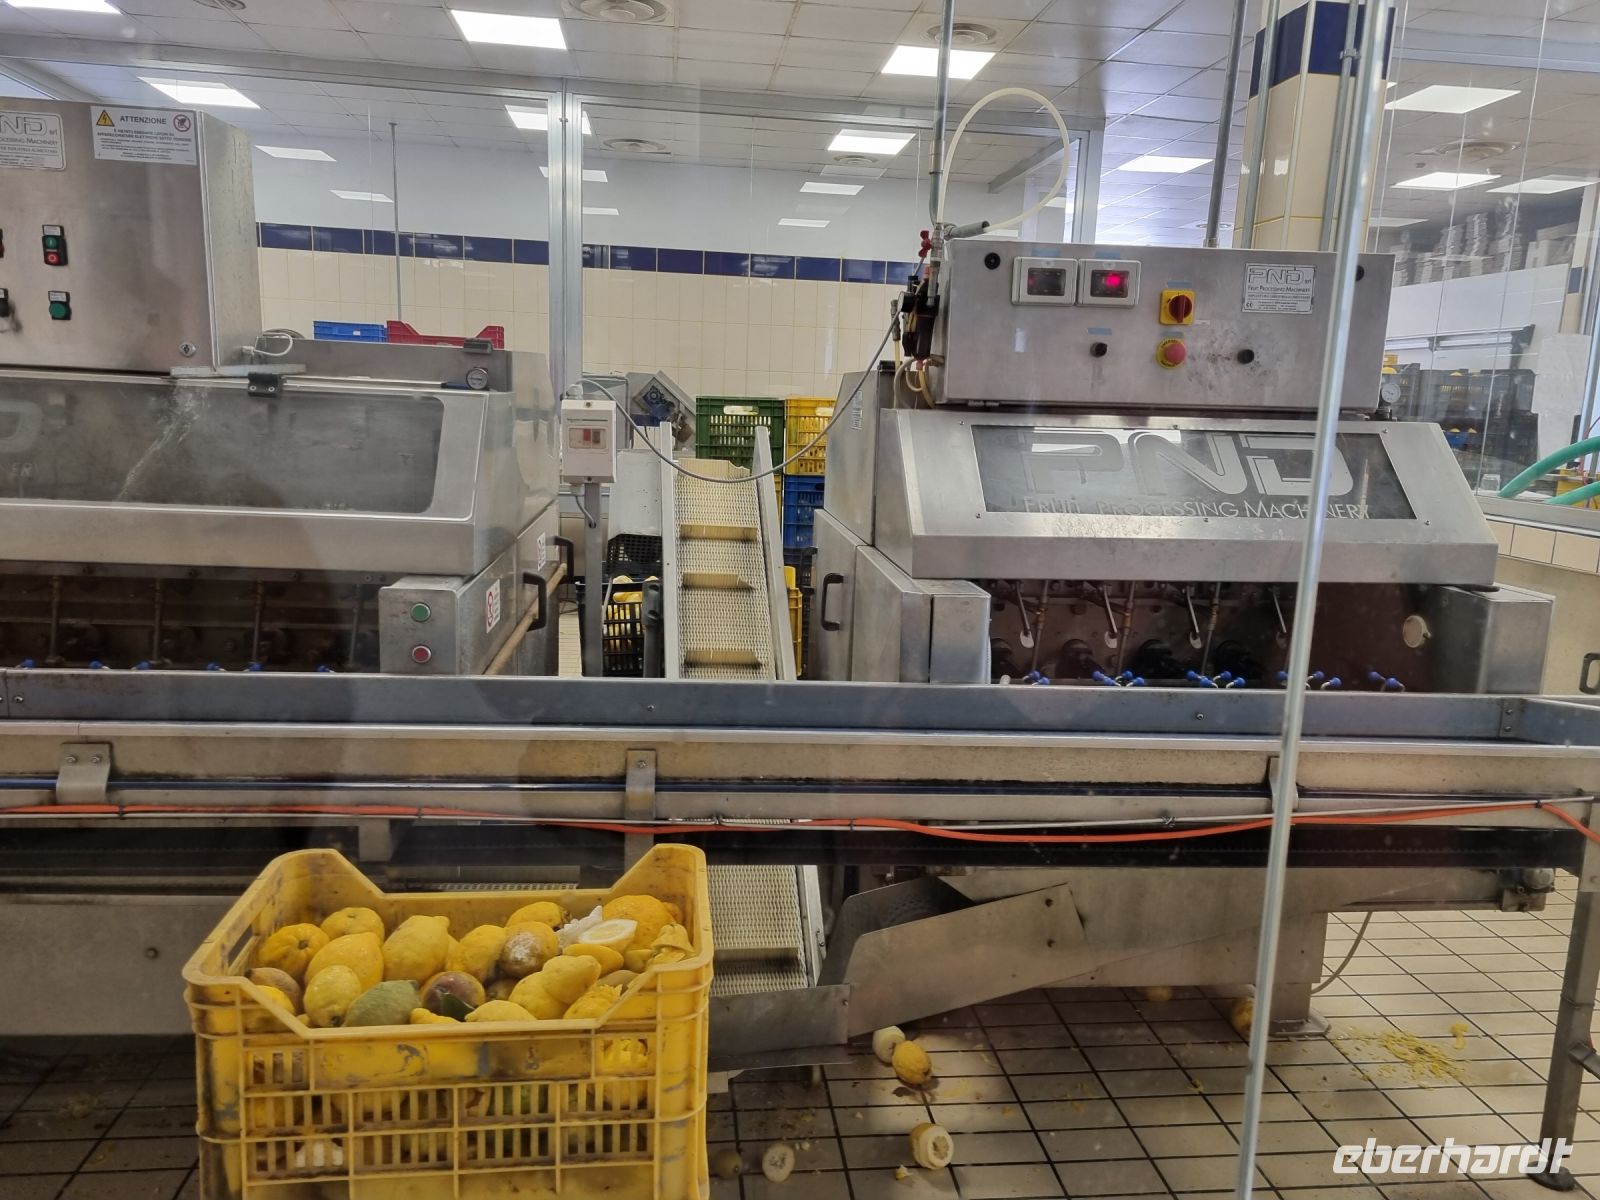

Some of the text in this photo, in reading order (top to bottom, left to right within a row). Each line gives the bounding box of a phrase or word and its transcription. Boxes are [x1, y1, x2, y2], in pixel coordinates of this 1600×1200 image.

[0, 114, 47, 136] ND
[120, 115, 167, 125] ATTENZIONE
[1248, 268, 1304, 285] PND
[1019, 429, 1354, 497] PND
[1096, 500, 1239, 518] PROCESSING
[1244, 500, 1370, 519] MACHNERY
